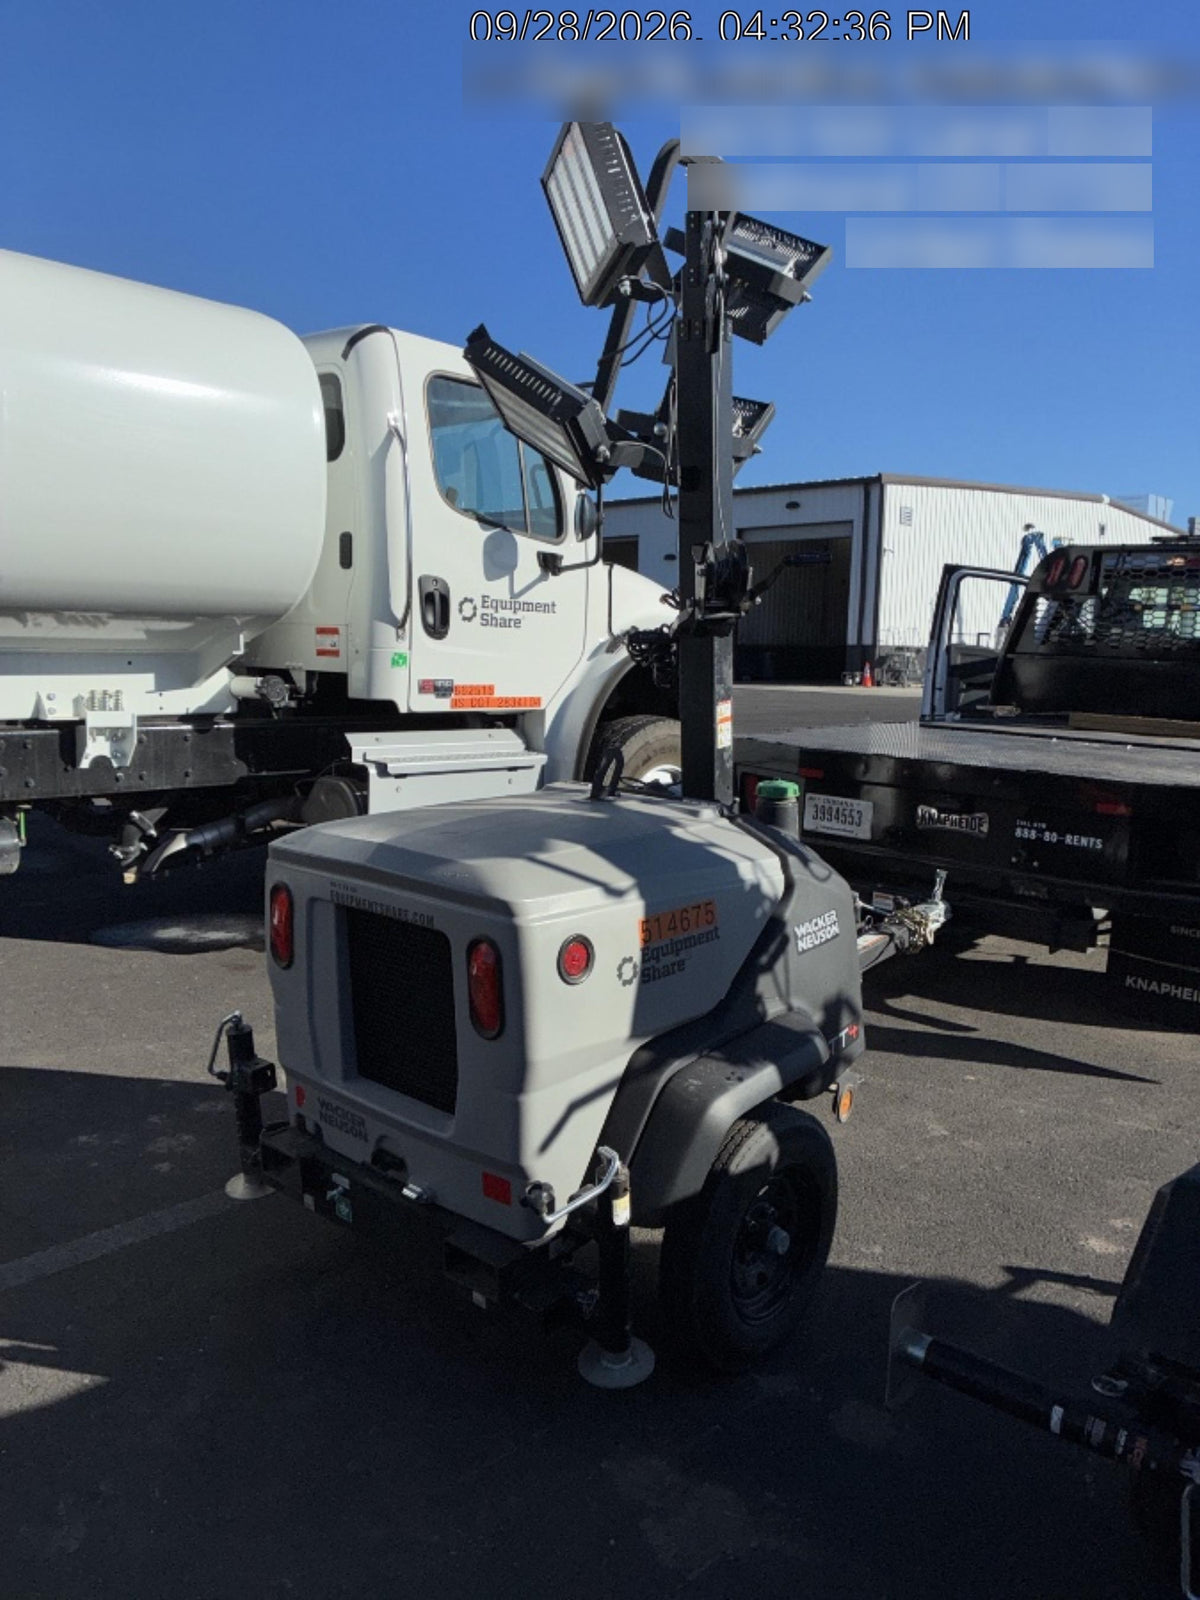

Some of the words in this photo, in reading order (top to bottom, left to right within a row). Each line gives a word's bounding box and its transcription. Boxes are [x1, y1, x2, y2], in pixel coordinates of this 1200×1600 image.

[480, 595, 557, 615] Equipment
[480, 613, 522, 629] Share
[812, 803, 863, 827] 3994553
[1015, 827, 1104, 849] 888-80-RENTS
[641, 901, 715, 944] 514675
[794, 909, 839, 938] WACKER
[642, 926, 720, 964] Equipment
[797, 922, 840, 951] NEUSON
[641, 959, 686, 984] Share
[1125, 975, 1200, 1004] KNAPHEI
